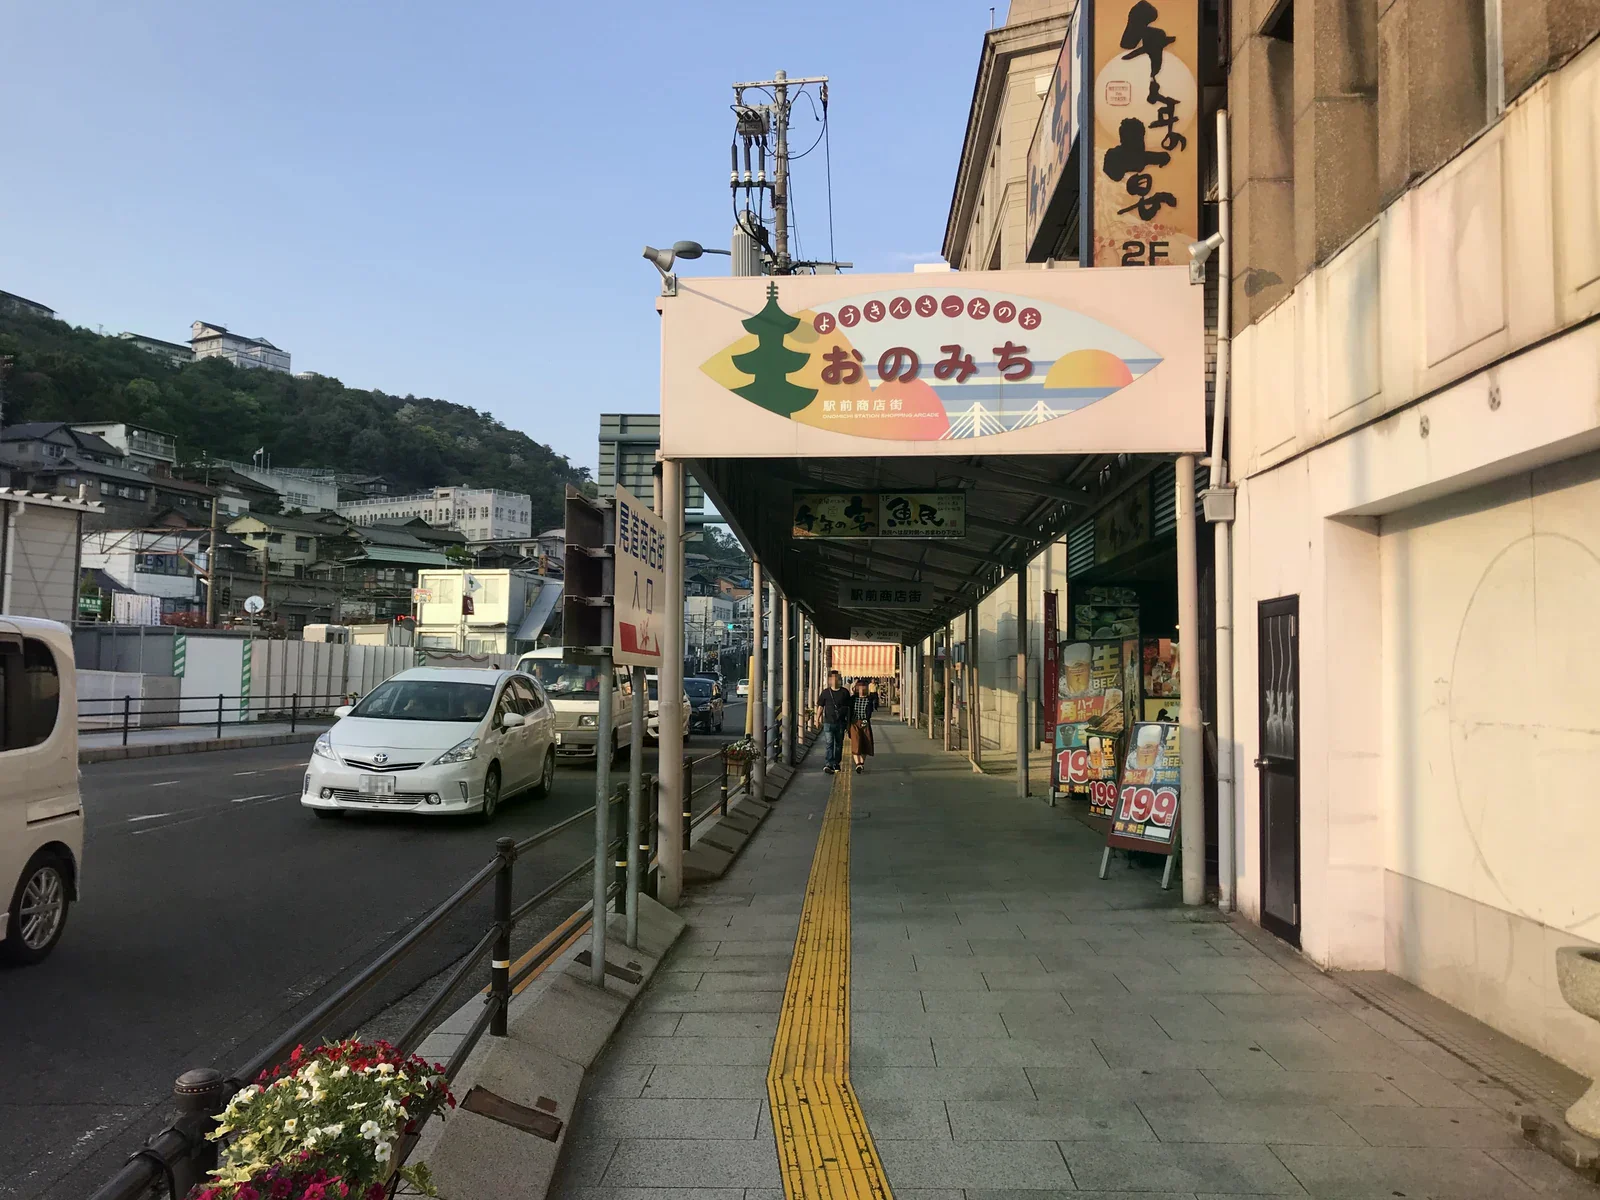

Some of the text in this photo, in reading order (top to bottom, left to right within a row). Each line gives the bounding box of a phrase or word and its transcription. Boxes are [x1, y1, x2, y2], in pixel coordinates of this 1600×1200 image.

[1122, 241, 1169, 267] 2F
[819, 297, 1038, 332] ようきんさったのお
[821, 341, 1034, 385] おのみち
[823, 399, 902, 411] 駅前商店街
[886, 497, 944, 527] 魚民
[619, 501, 664, 573] 尾道商店街
[632, 570, 653, 614] 入口
[851, 588, 922, 602] 駅前商店街
[1092, 645, 1119, 677] 生
[1093, 677, 1116, 689] BEE
[1057, 749, 1089, 784] 19
[1089, 780, 1118, 809] 199
[1120, 786, 1177, 826] 199
